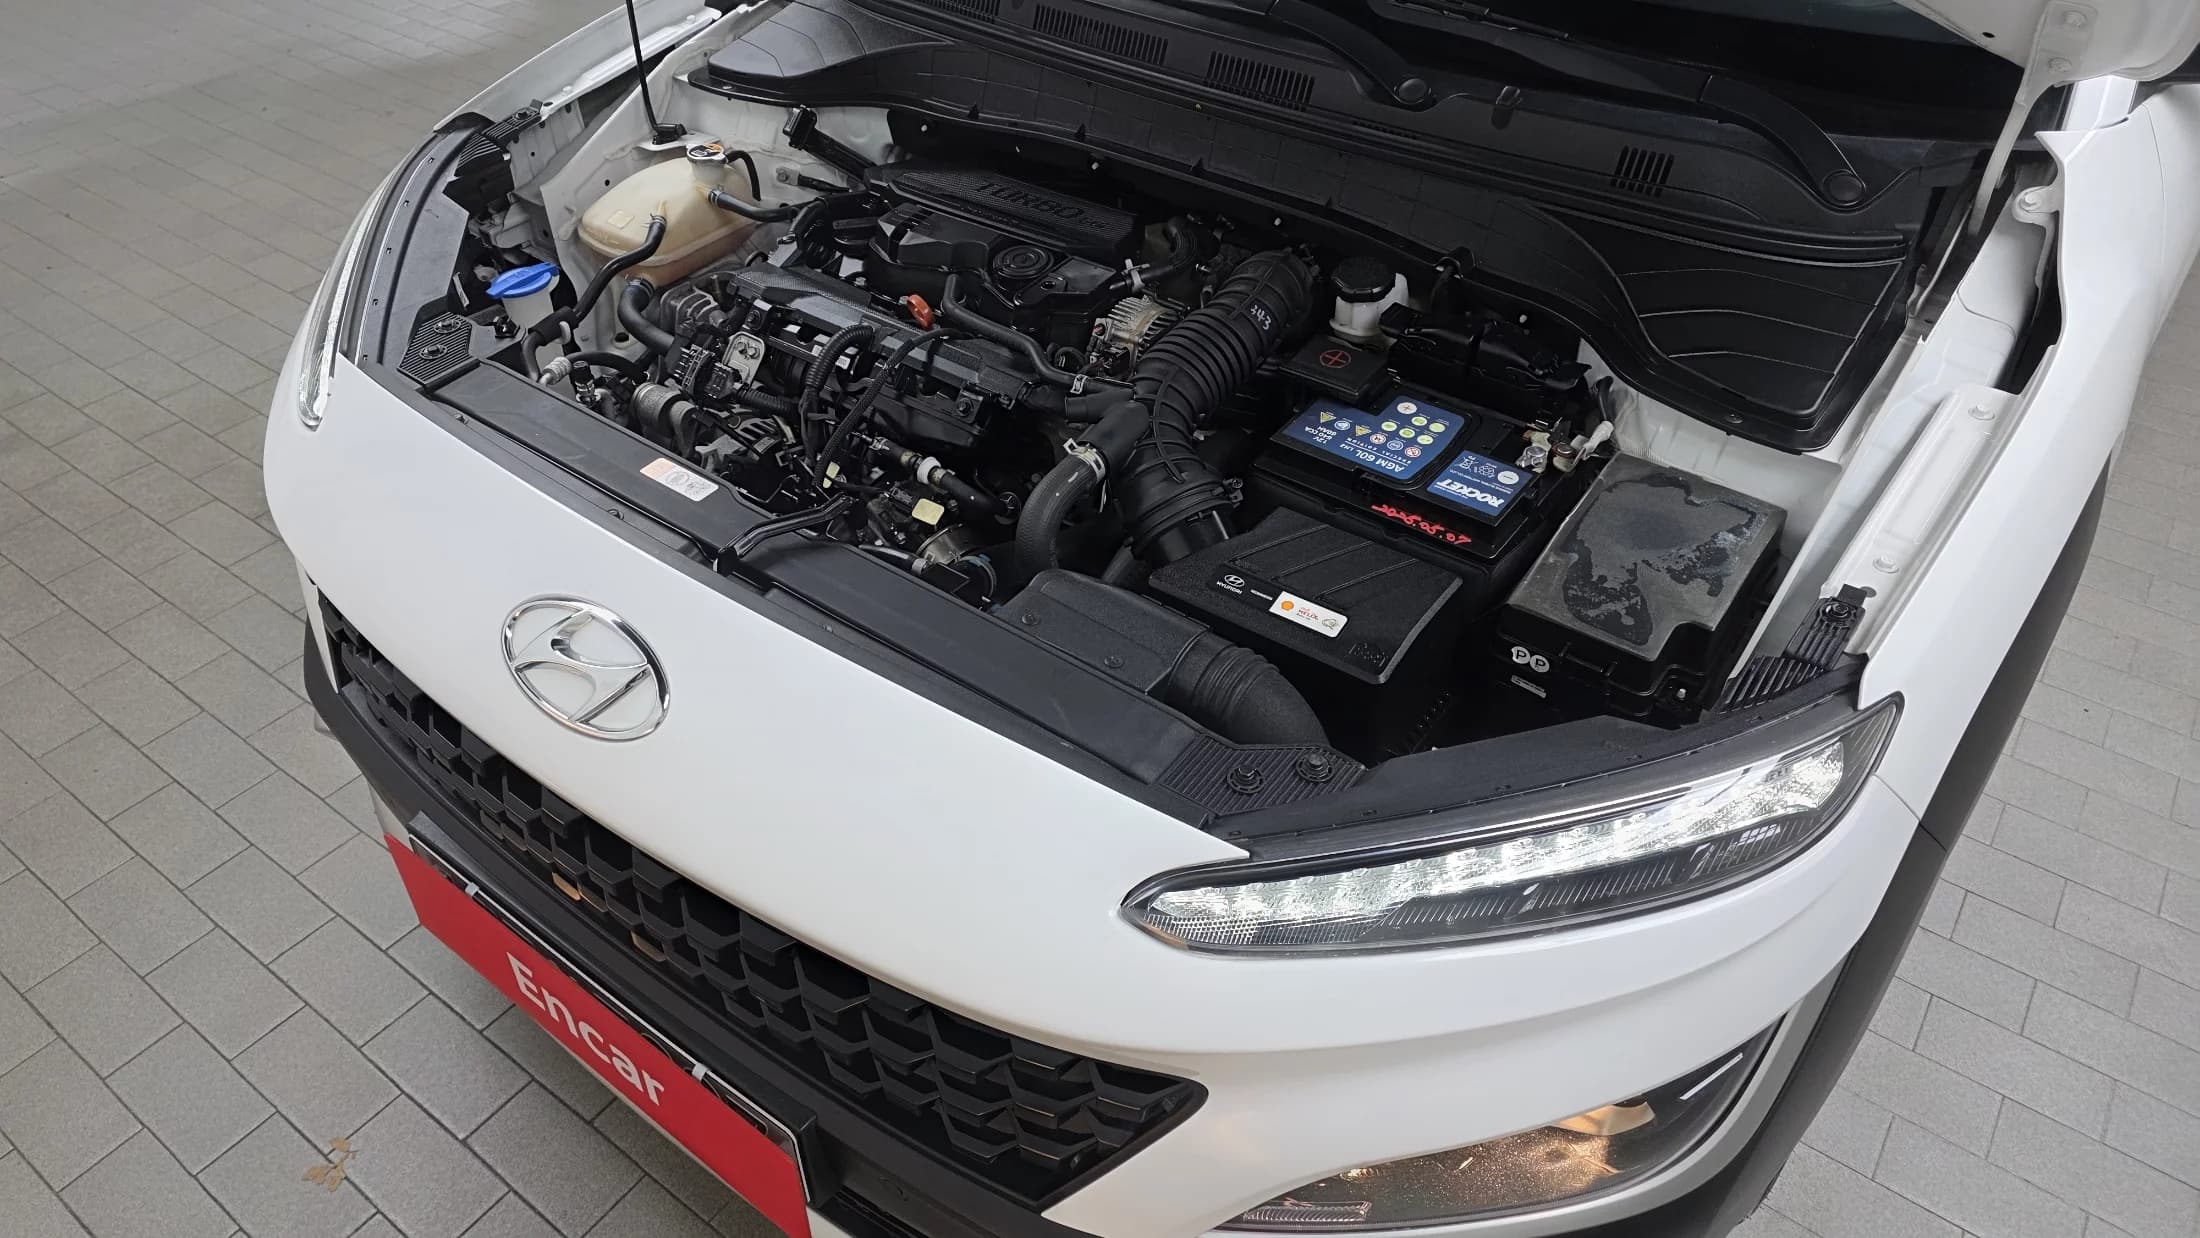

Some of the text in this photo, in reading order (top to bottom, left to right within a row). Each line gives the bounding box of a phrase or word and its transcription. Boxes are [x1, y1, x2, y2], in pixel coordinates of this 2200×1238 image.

[976, 181, 1084, 219] TURBO
[1250, 304, 1272, 330] 343
[1304, 426, 1319, 435] CCA
[1313, 436, 1328, 444] 12V
[1347, 437, 1412, 464] SPECIAL EDITION
[1355, 449, 1376, 462] 60L
[1376, 457, 1405, 473] AGM
[1436, 478, 1505, 508] ROCKET
[1216, 580, 1243, 595] HYUNDAI
[506, 951, 665, 1106] Encar
